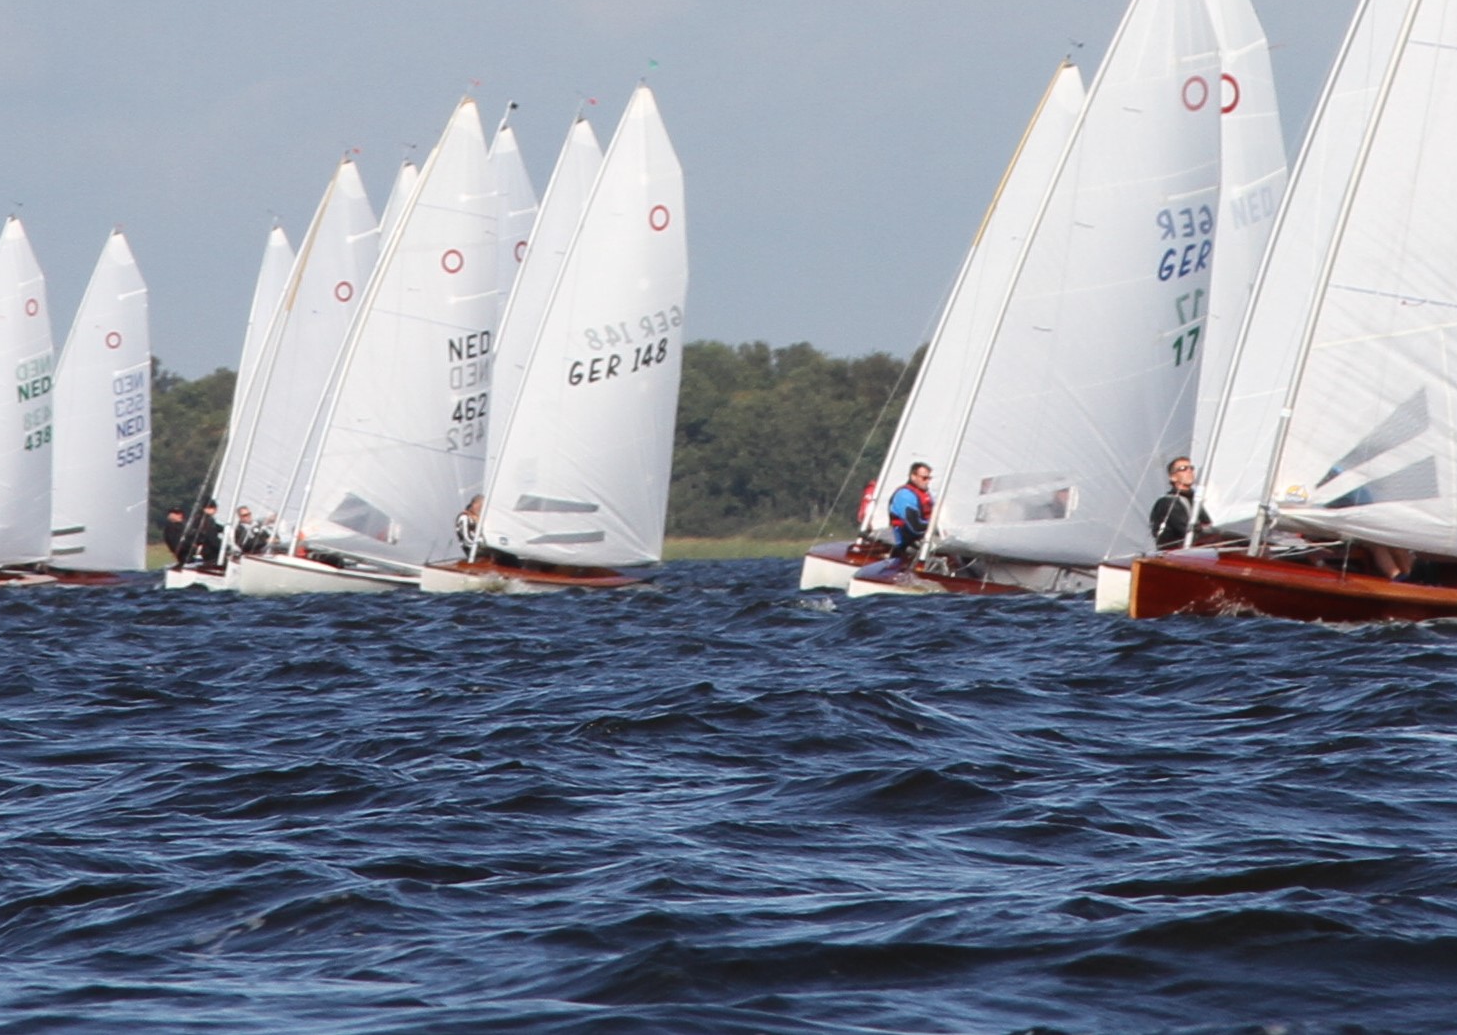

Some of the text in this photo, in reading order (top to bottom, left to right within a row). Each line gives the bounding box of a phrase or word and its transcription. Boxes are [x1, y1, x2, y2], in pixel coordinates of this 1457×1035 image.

[1158, 240, 1212, 281] GER
[448, 330, 490, 362] NED
[1172, 326, 1200, 366] 17
[568, 337, 667, 386] GER 148
[17, 376, 52, 403] NED
[452, 393, 488, 423] 462
[24, 425, 52, 450] 438
[116, 415, 144, 439] NED
[117, 443, 144, 467] 553
